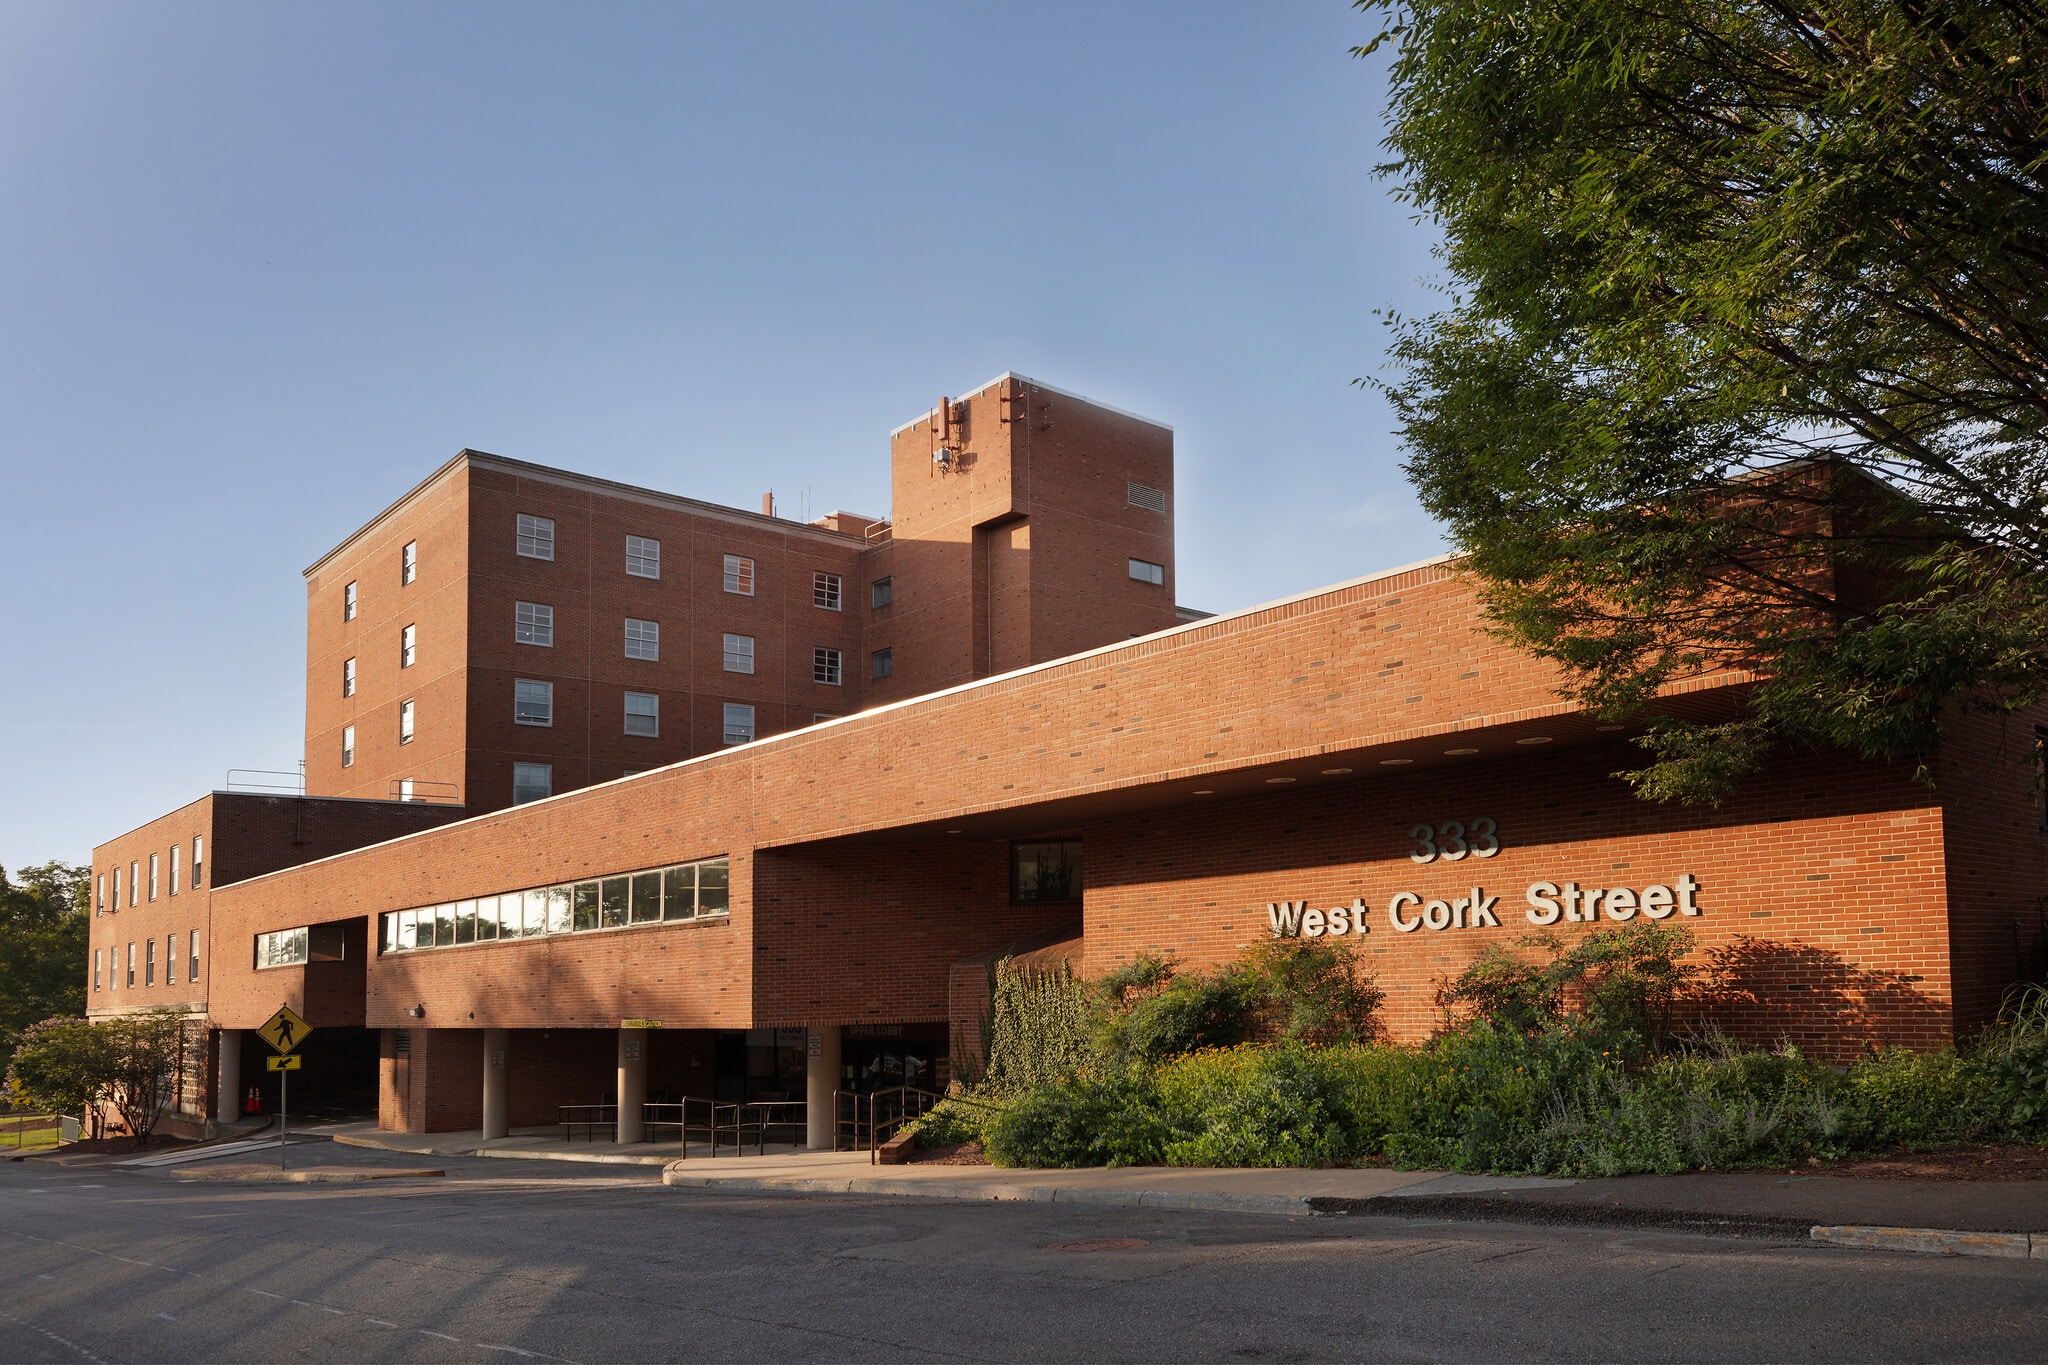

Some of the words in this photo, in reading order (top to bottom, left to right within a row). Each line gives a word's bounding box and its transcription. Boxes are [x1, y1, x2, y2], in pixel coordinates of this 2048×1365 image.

[1409, 816, 1500, 864] 333
[1266, 897, 1369, 938] West
[1388, 886, 1500, 932] Cork
[1525, 873, 1701, 925] Street
[849, 1025, 875, 1035] UPPER
[876, 1025, 903, 1035] LOBBY
